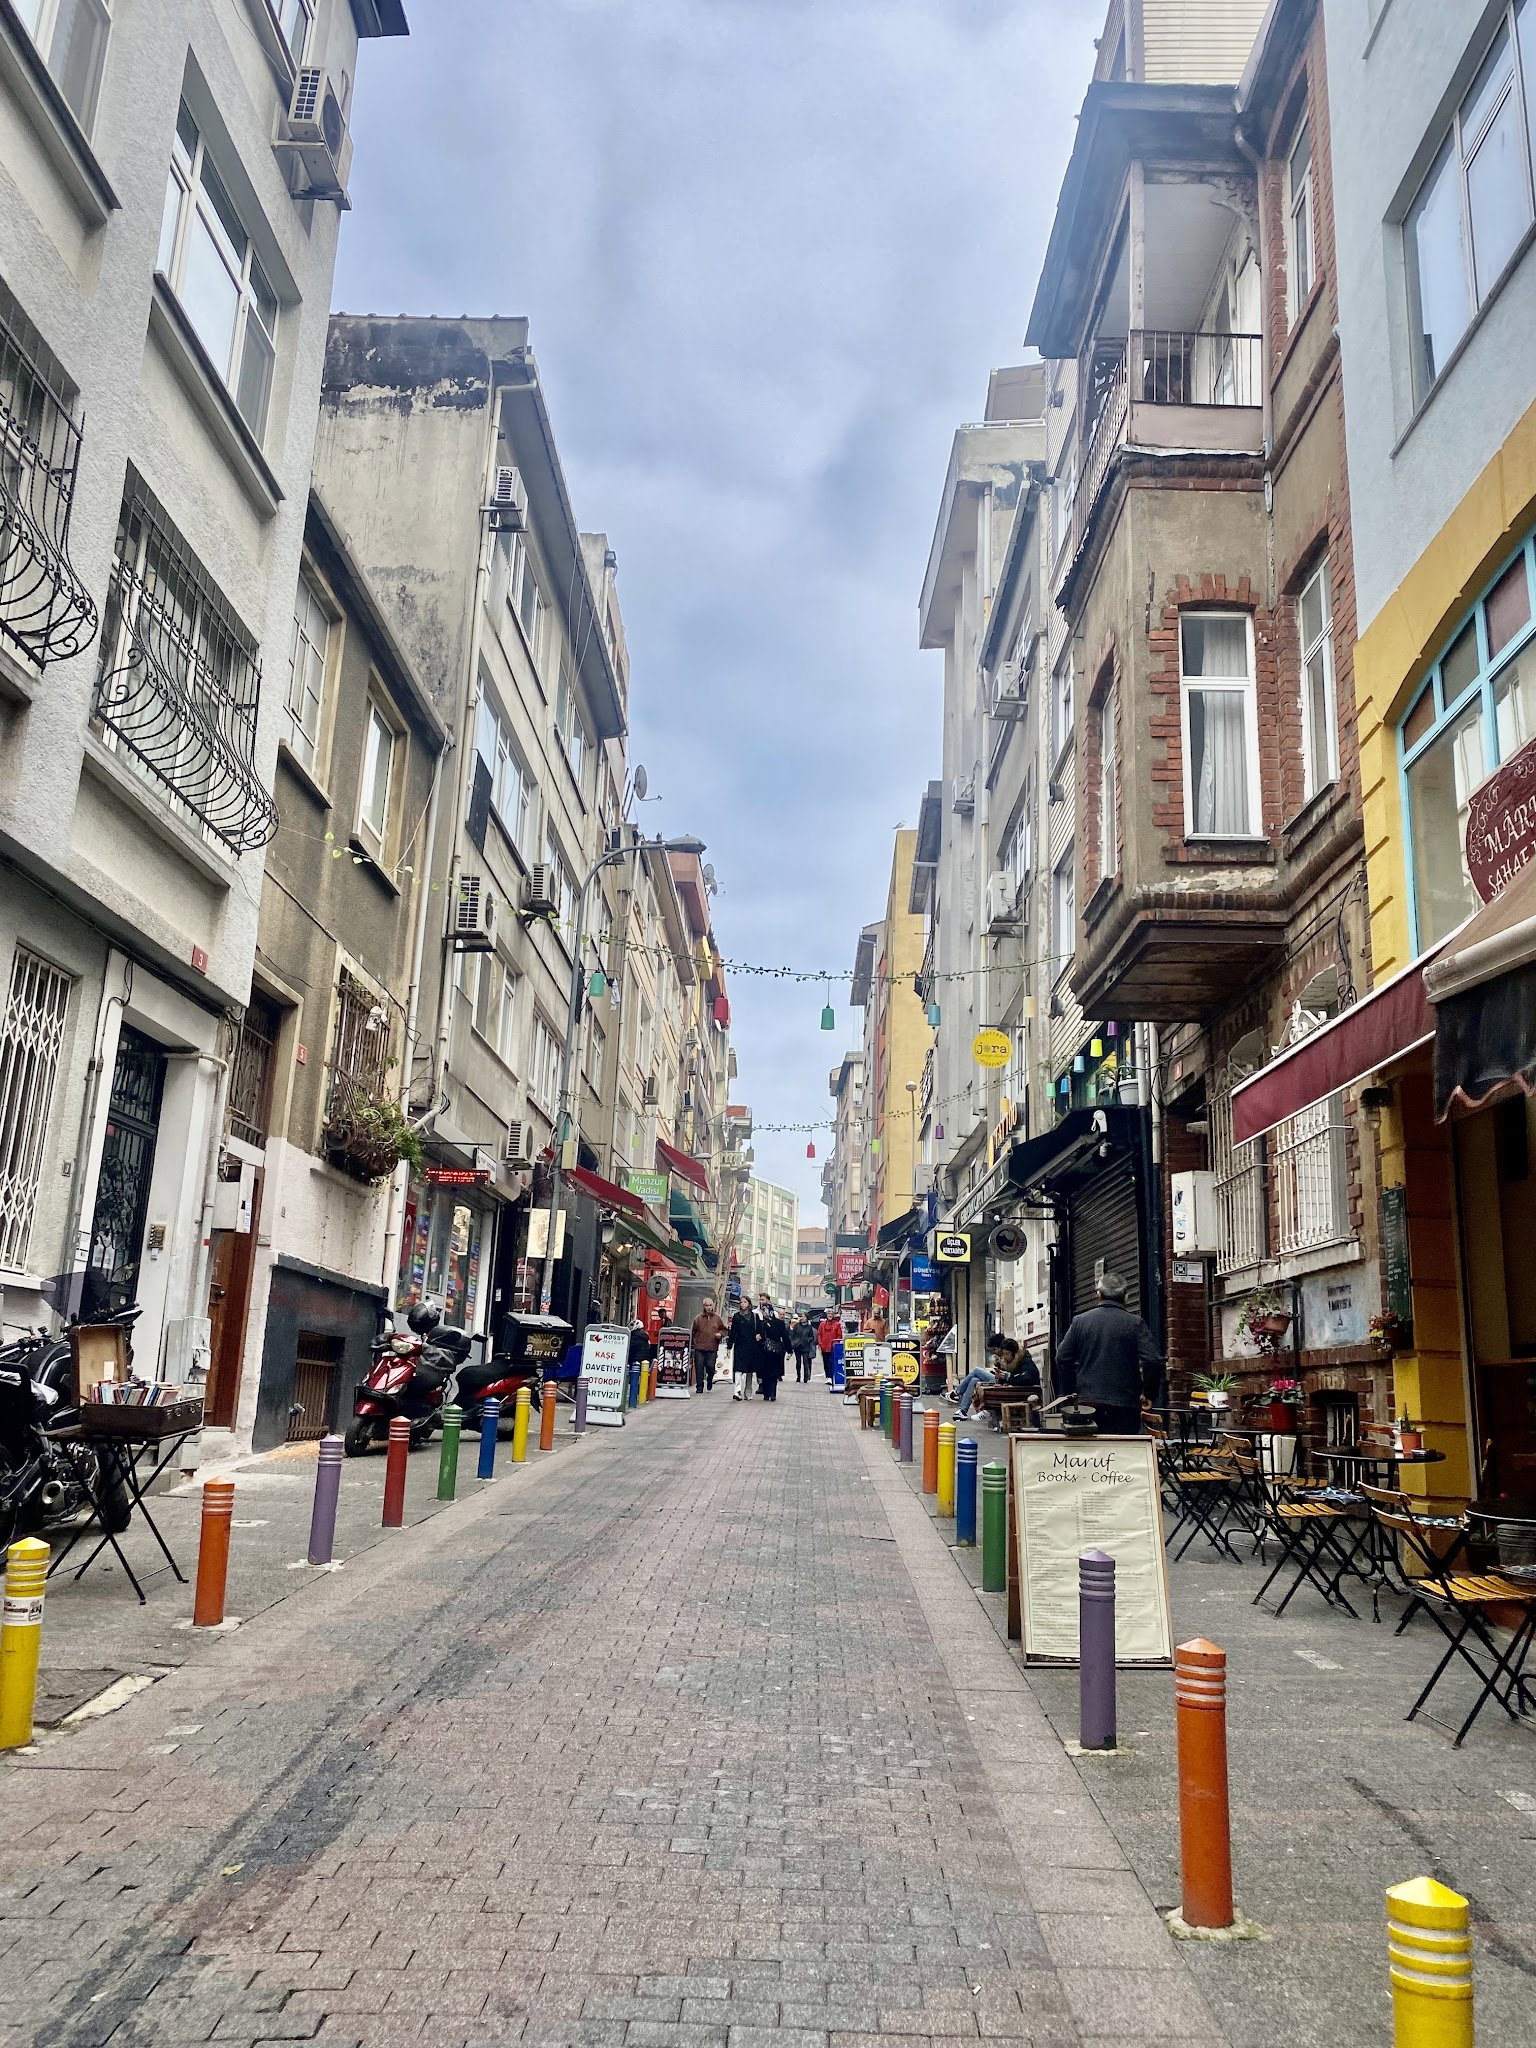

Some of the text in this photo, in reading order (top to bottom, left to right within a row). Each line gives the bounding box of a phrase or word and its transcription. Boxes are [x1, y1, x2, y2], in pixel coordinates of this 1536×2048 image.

[198, 954, 204, 966] 3
[300, 1050, 305, 1060] 5
[631, 1176, 665, 1186] Munzur
[946, 1237, 961, 1247] ÜÇLER
[595, 1351, 616, 1360] KAŞE
[585, 1363, 623, 1374] DAVETİYE
[588, 1376, 622, 1387] OTOKOPİ
[586, 1389, 621, 1400] ARTVİZİT
[1053, 1452, 1116, 1472] Maruf
[1036, 1470, 1080, 1483] Books
[1091, 1470, 1135, 1485] Coffee
